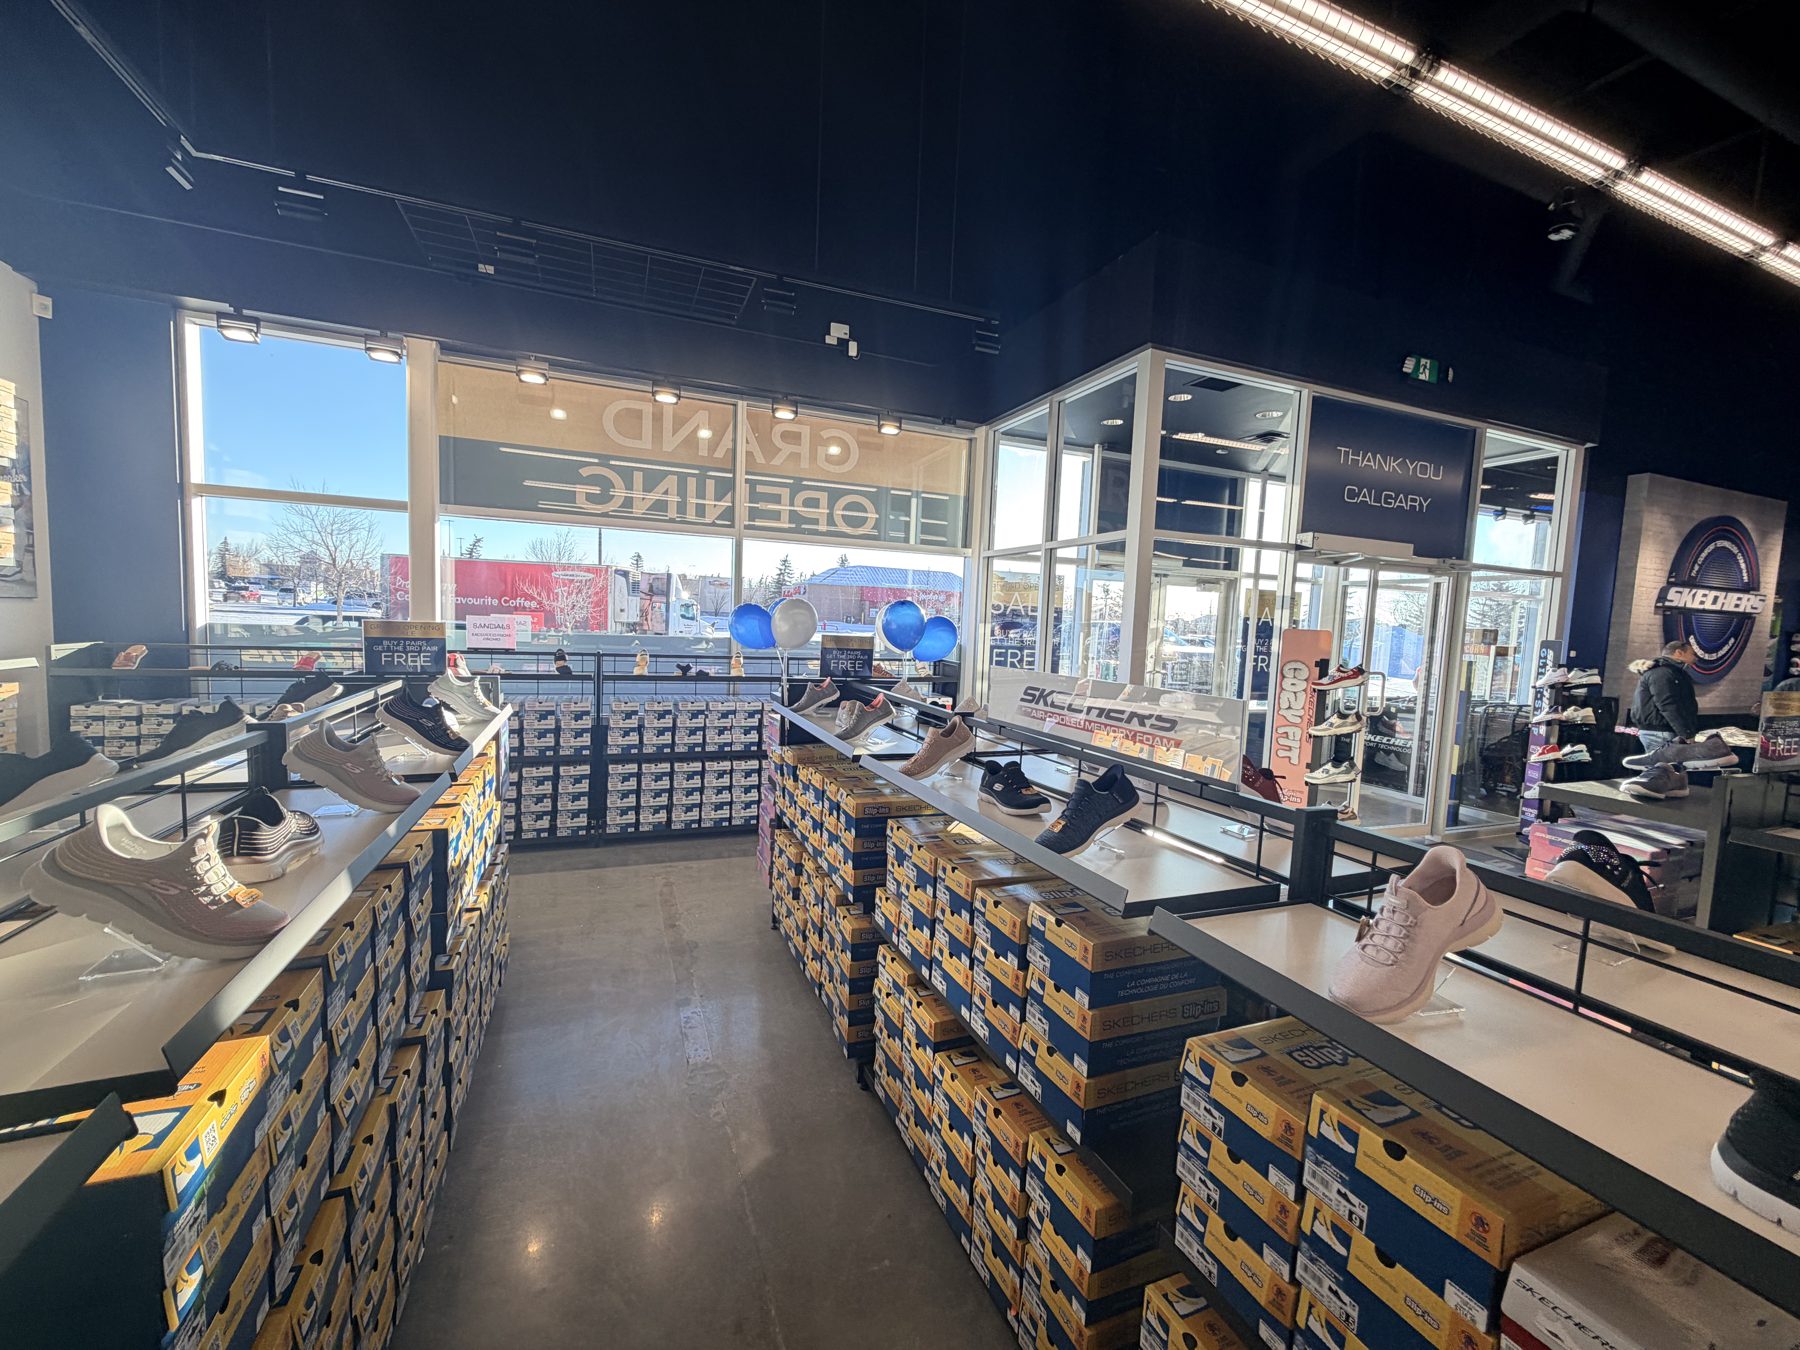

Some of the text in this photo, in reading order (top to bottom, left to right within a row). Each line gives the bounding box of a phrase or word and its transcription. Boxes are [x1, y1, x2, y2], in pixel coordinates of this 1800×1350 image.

[1336, 446, 1443, 480] THANK YOU
[1344, 485, 1432, 513] CALGARY
[450, 594, 499, 607] Favourite
[991, 592, 1057, 616] SAL
[1664, 587, 1767, 614] SKECHERS
[473, 622, 511, 630] SANDALS
[381, 652, 432, 666] FREE
[830, 660, 863, 671] FREE
[992, 649, 1036, 669] FRE
[1019, 685, 1179, 733] SKECHERS
[1276, 660, 1311, 765] COZY FIT
[1031, 709, 1176, 749] AIR-COOLED MEMORY FOAM
[1377, 743, 1412, 754] TECHNOLOG
[1768, 737, 1800, 757] FREE
[863, 805, 889, 816] Slip-ins
[1041, 886, 1085, 900] Slip-i
[1126, 980, 1136, 988] LA
[1102, 1000, 1220, 1032] SKECHERS Slip-ins
[1258, 1029, 1313, 1045] SKECH
[1291, 1041, 1356, 1068] Slip-i
[1246, 1103, 1270, 1126] Slip-ins
[1213, 1125, 1221, 1137] 7
[1413, 1183, 1450, 1216] Slip-ins
[1351, 1213, 1361, 1227] 9
[1404, 1294, 1441, 1331] Slip-ins
[1512, 1278, 1619, 1350] SKECHER
